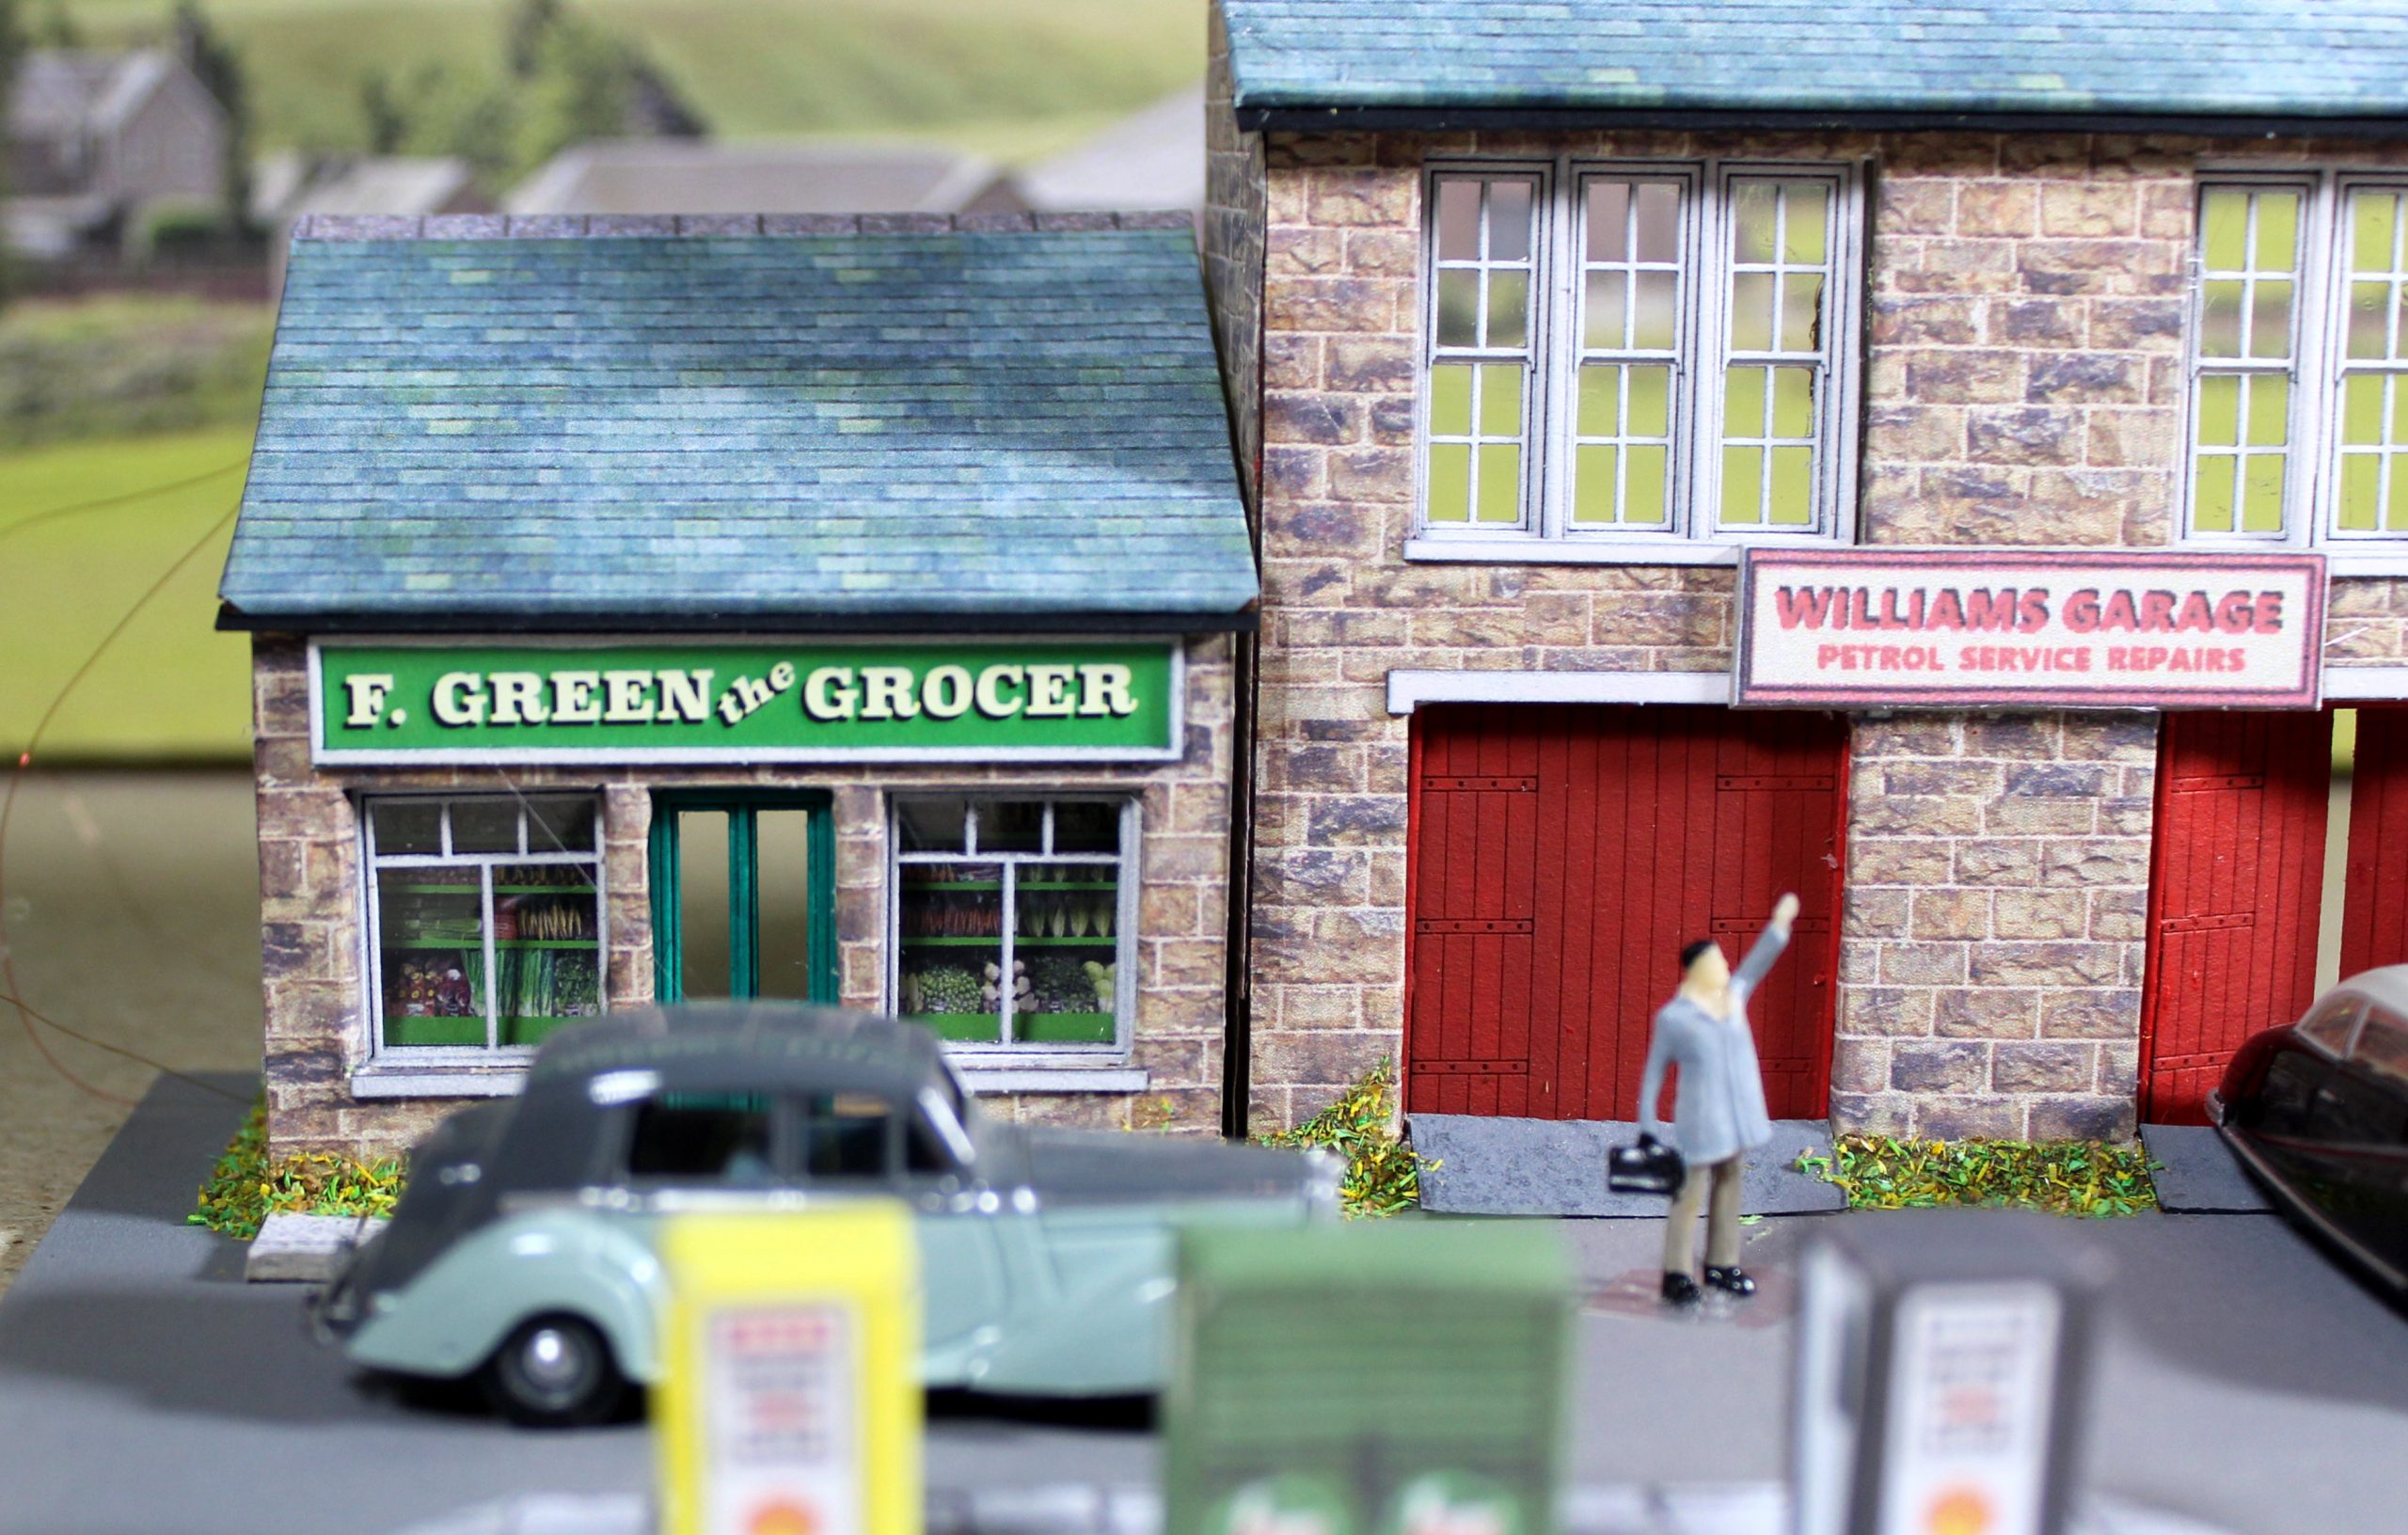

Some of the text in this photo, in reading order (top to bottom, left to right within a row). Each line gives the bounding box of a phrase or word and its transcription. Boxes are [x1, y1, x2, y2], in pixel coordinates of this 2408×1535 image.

[1774, 586, 2285, 635] WILLIAMS GARAGE
[1817, 644, 2246, 672] PETROL SERVICE REPAIRS
[342, 661, 1139, 729] F. GREEN the GROCER
